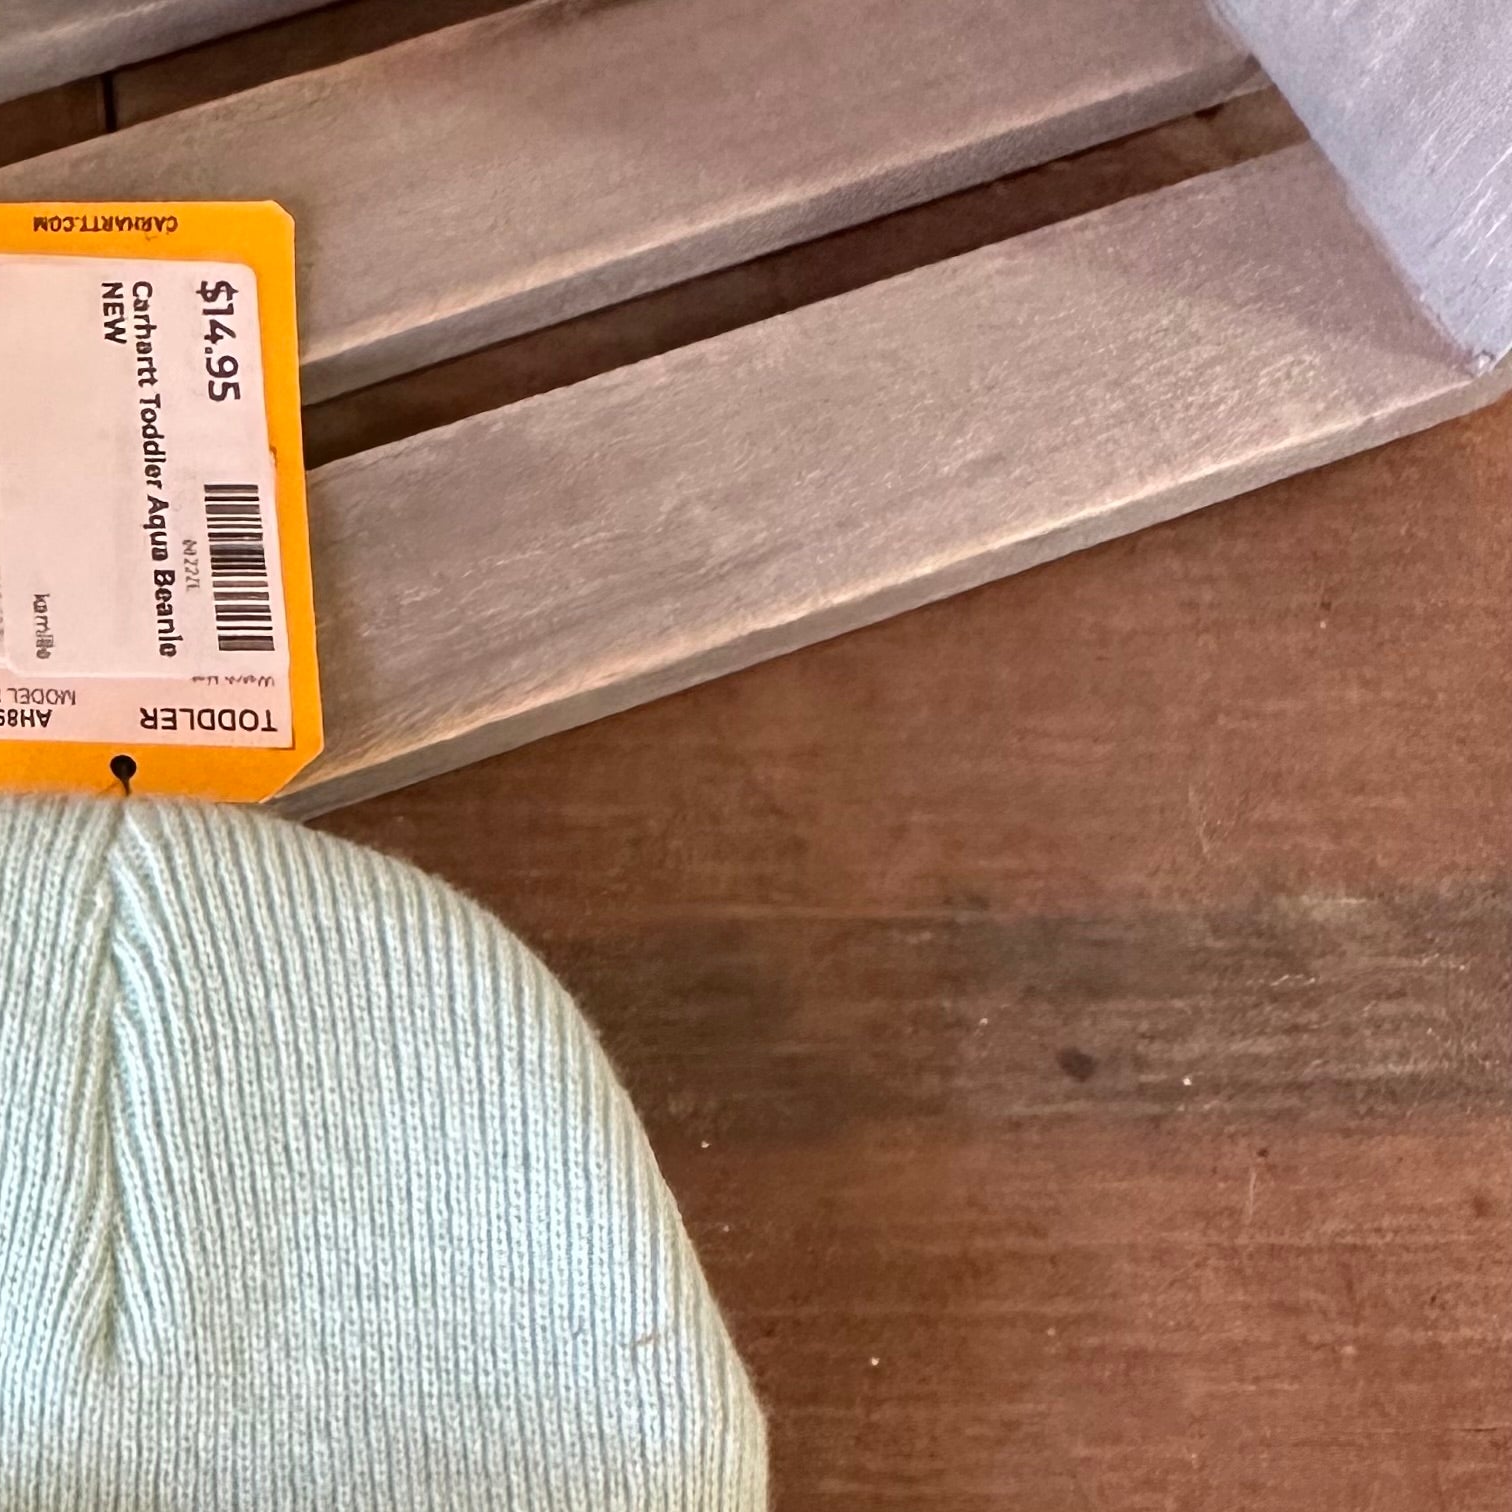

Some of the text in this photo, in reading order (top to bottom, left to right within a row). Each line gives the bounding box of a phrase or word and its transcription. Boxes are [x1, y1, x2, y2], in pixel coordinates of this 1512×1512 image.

[33, 216, 178, 232] CARHARTT.COM
[102, 282, 127, 345] NEW
[196, 280, 240, 401] $14.95
[132, 281, 183, 658] Carhartt Toddler Aqua Beanie
[7, 687, 76, 706] MODEL
[140, 707, 278, 732] TODDLER
